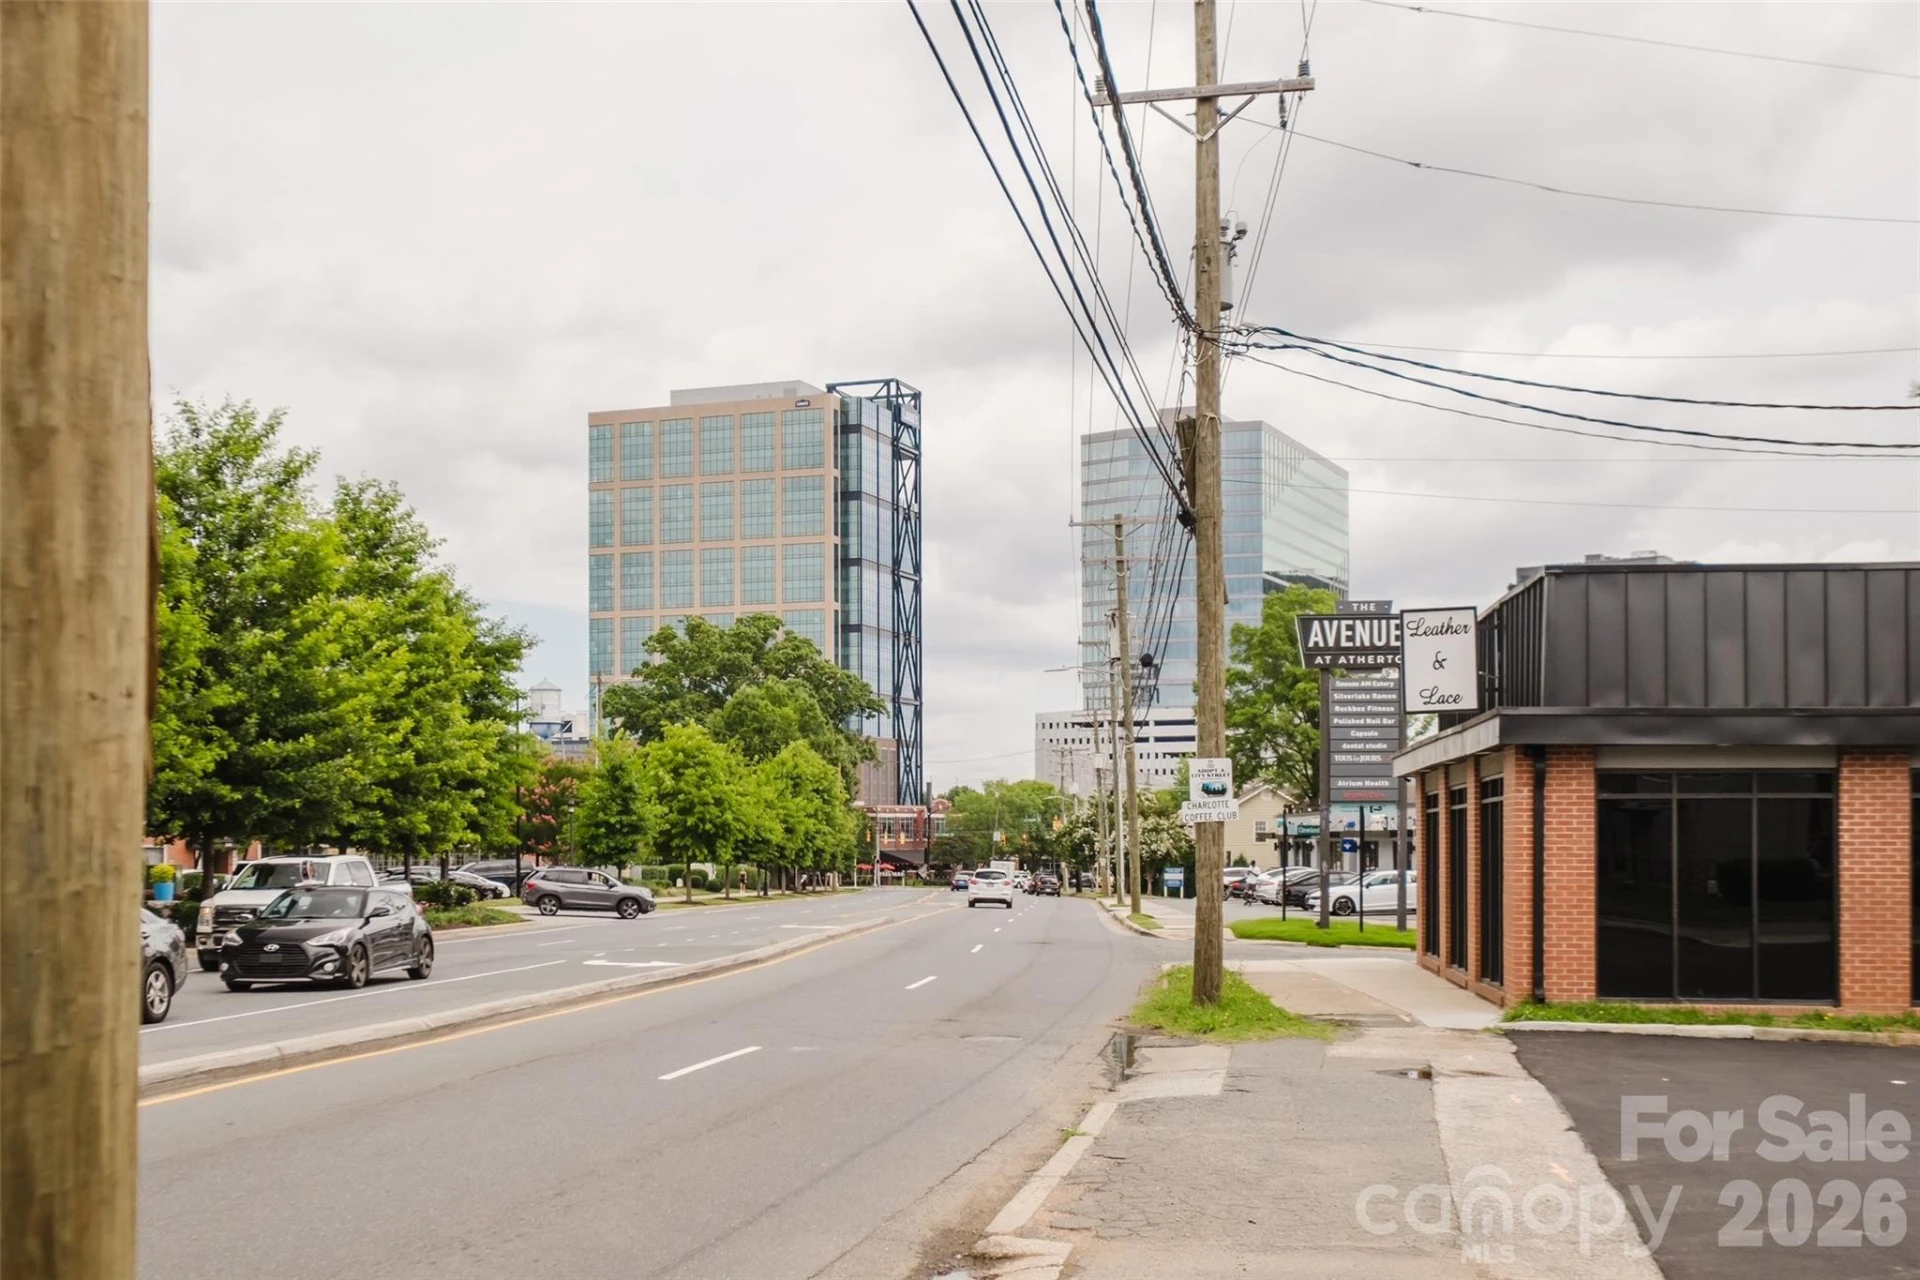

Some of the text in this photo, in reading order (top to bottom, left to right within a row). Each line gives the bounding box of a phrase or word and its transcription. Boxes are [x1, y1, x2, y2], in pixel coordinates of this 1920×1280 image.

[1351, 602, 1376, 612] THE
[1406, 616, 1471, 637] Leather
[1307, 619, 1400, 648] AVENUE
[1314, 654, 1401, 665] AT ATHERTO
[1433, 651, 1447, 670] &
[1360, 680, 1371, 688] AM
[1371, 680, 1395, 689] Eatery
[1333, 692, 1397, 700] Silverlake Ramen
[1419, 685, 1463, 706] Lace
[1333, 717, 1396, 725] Polished Nail Bar
[1350, 730, 1379, 738] Capsule
[1334, 754, 1353, 762] TOUS
[1360, 754, 1382, 763] JOURS
[1186, 800, 1230, 810] CHARLOTTE
[1184, 811, 1238, 822] COFFEE CLUB
